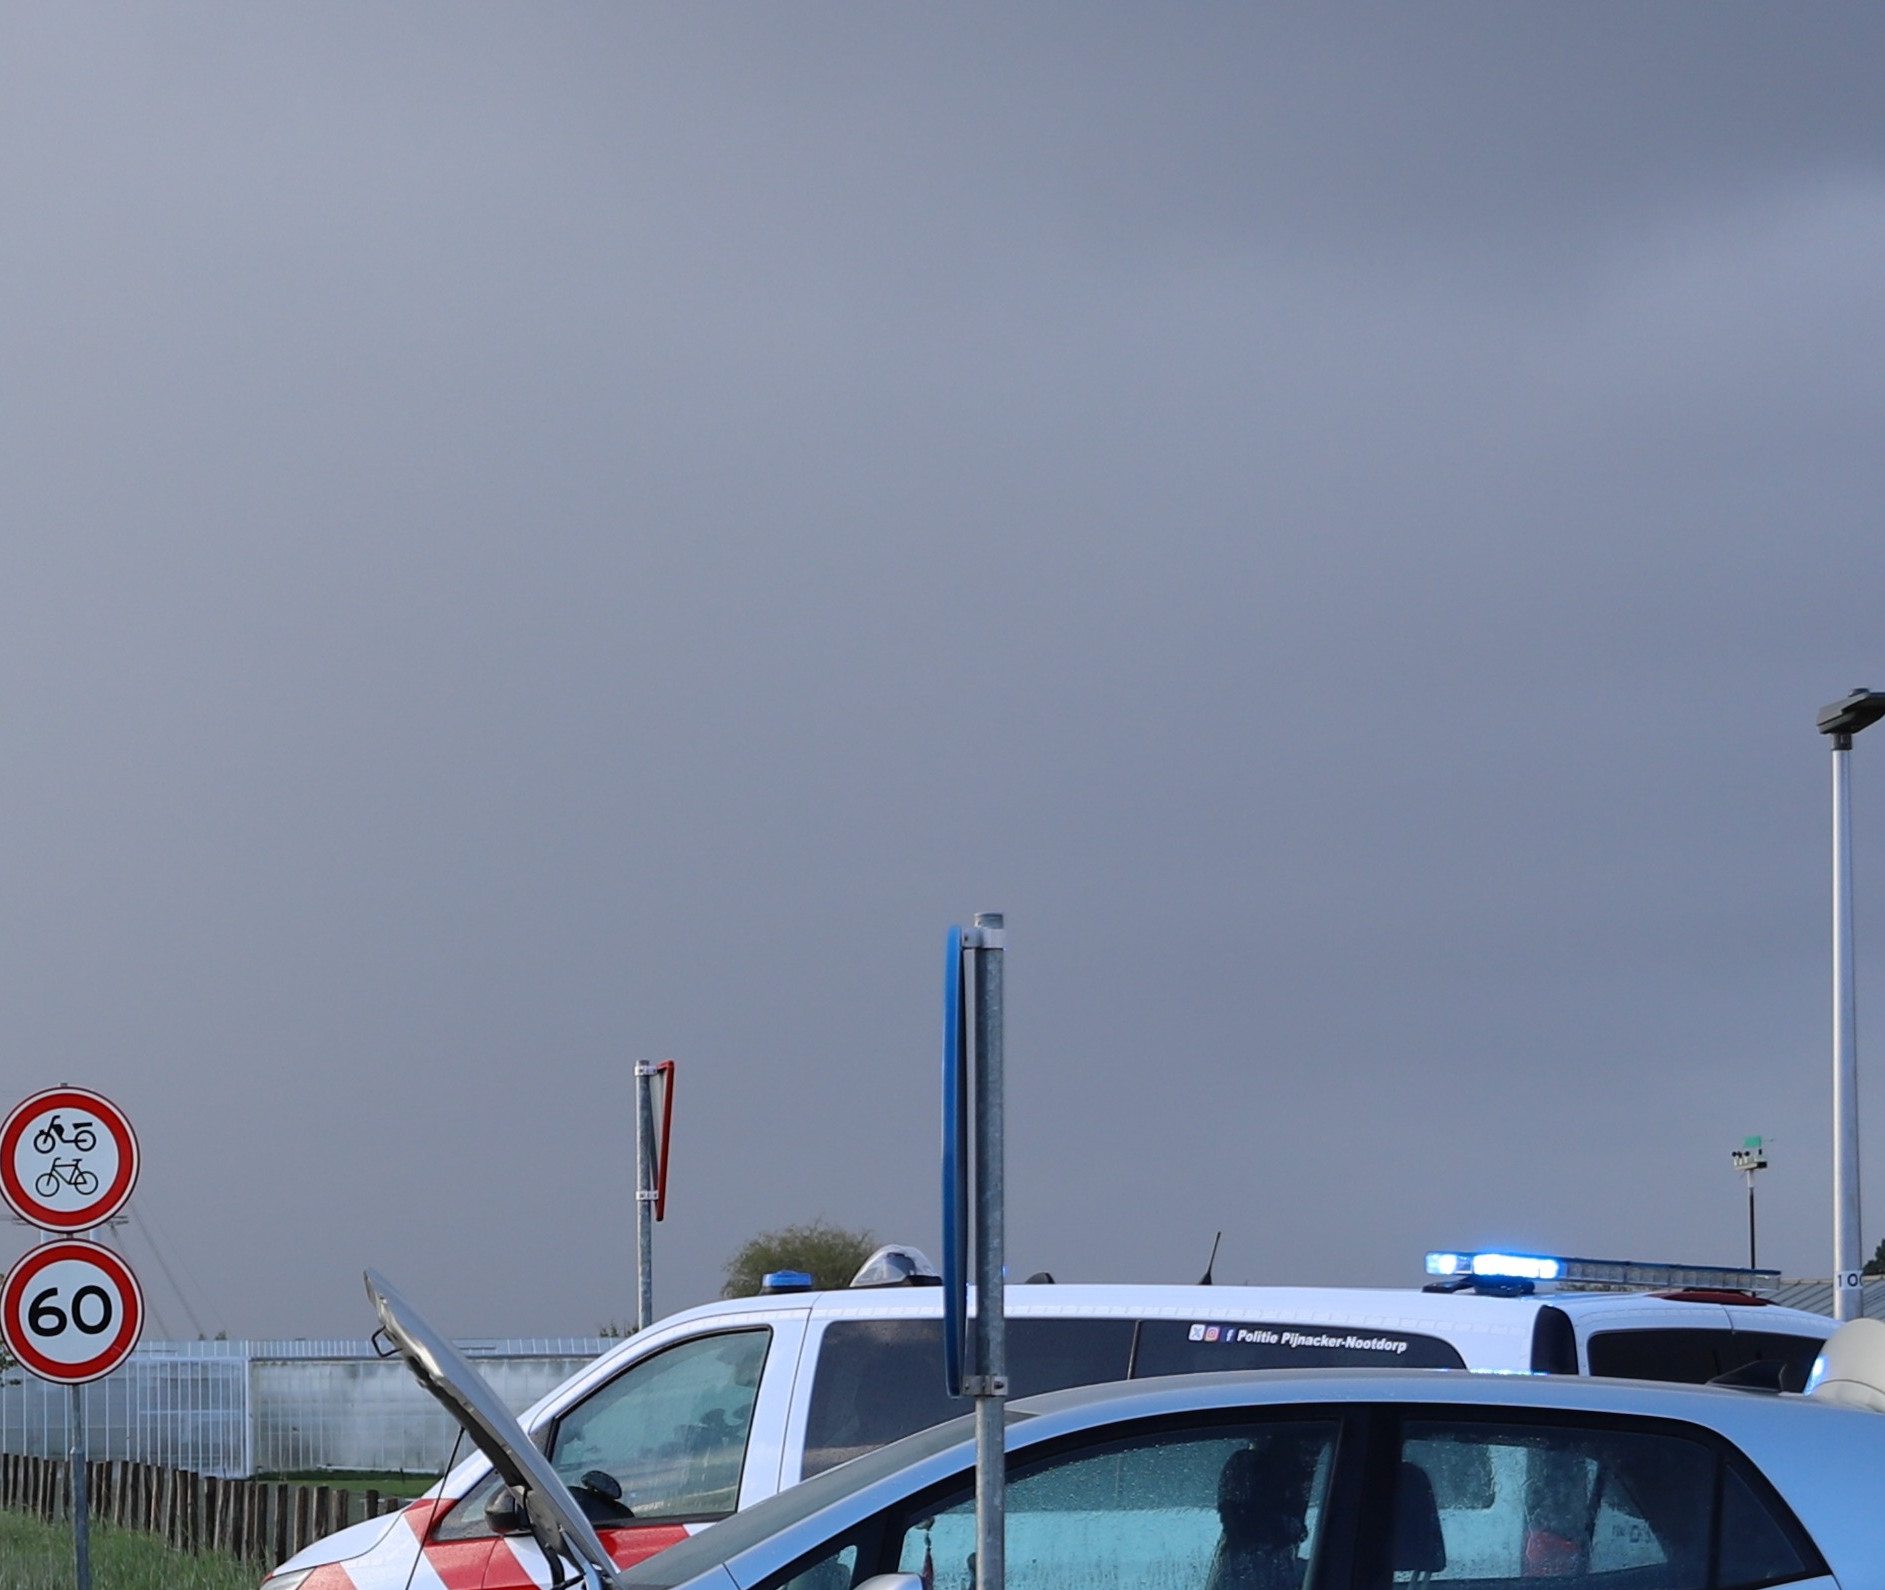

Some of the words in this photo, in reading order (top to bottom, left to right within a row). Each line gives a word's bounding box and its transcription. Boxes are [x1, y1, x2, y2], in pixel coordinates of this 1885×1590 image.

[28, 1284, 113, 1337] 60
[1237, 1329, 1279, 1344] Politie
[1280, 1332, 1408, 1354] Pijnacker-Nootdorp
